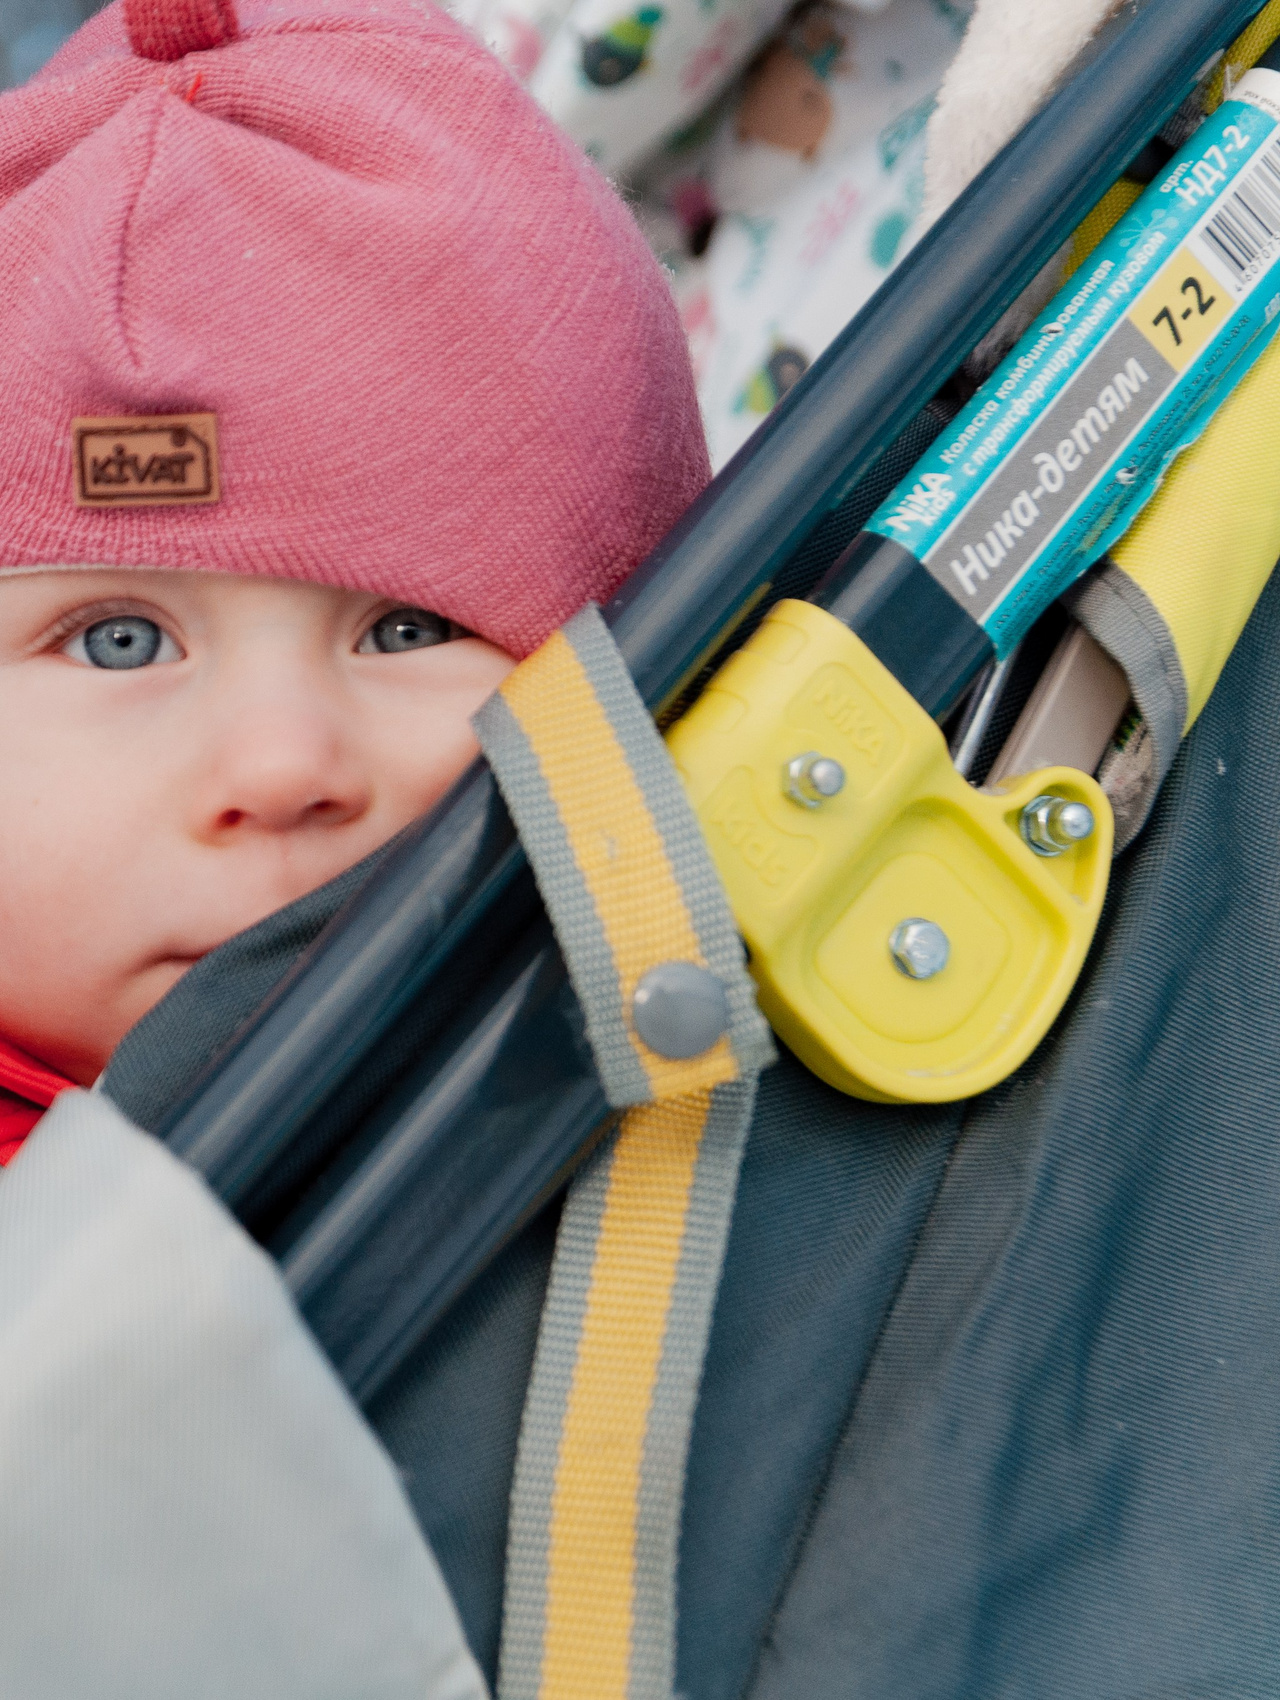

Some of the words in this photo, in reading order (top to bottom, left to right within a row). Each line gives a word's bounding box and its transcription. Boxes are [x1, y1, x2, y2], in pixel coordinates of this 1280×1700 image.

[1160, 160, 1195, 192] арт.
[1175, 125, 1251, 206] НД7-2
[1107, 231, 1167, 299] кузовом
[1153, 277, 1216, 347] 7-2
[940, 400, 1001, 464] Коляска
[995, 260, 1115, 400] комбиниованная
[969, 297, 1115, 467] трансформируемым
[951, 358, 1148, 595] Ника-детям
[962, 462, 978, 477] с
[915, 488, 957, 527] kids
